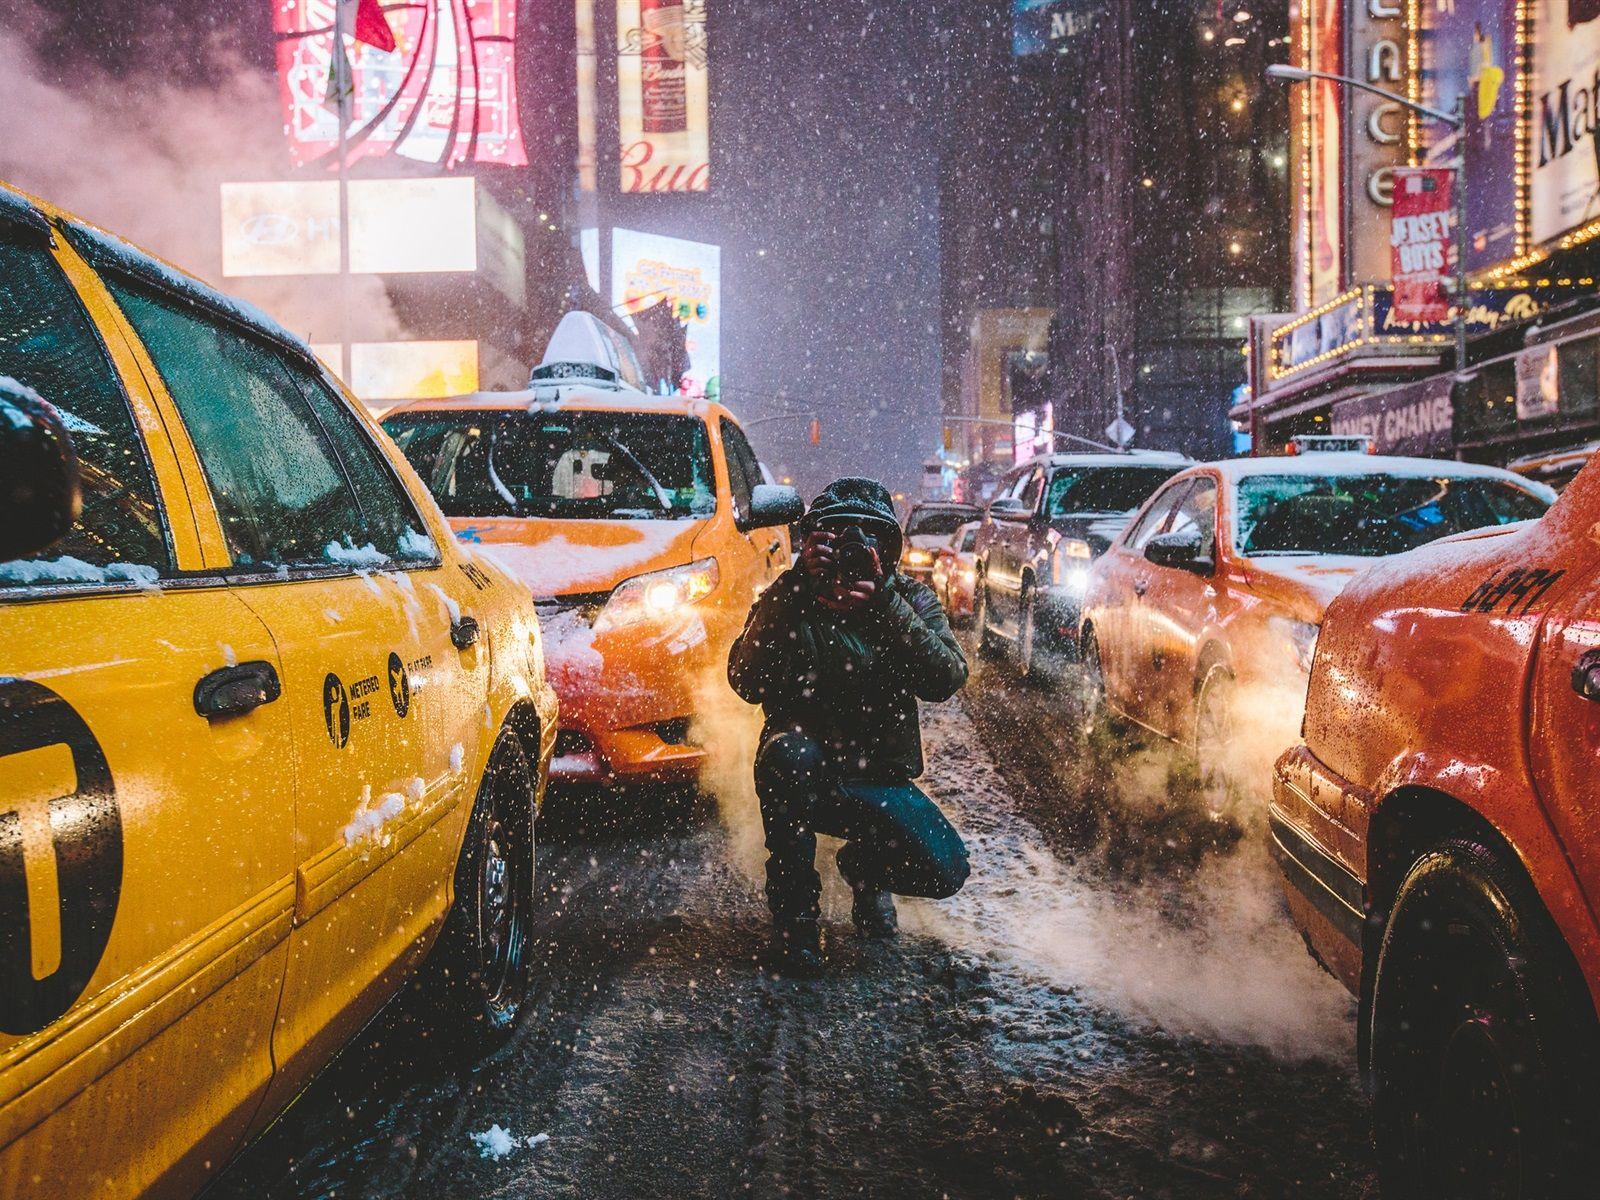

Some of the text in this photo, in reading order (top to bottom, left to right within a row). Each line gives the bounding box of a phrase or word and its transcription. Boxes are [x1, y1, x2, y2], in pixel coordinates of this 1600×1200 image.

[1391, 210, 1450, 246] JERSEY
[1401, 241, 1444, 274] BOYS
[349, 675, 379, 700] METERED
[353, 701, 370, 720] FARE
